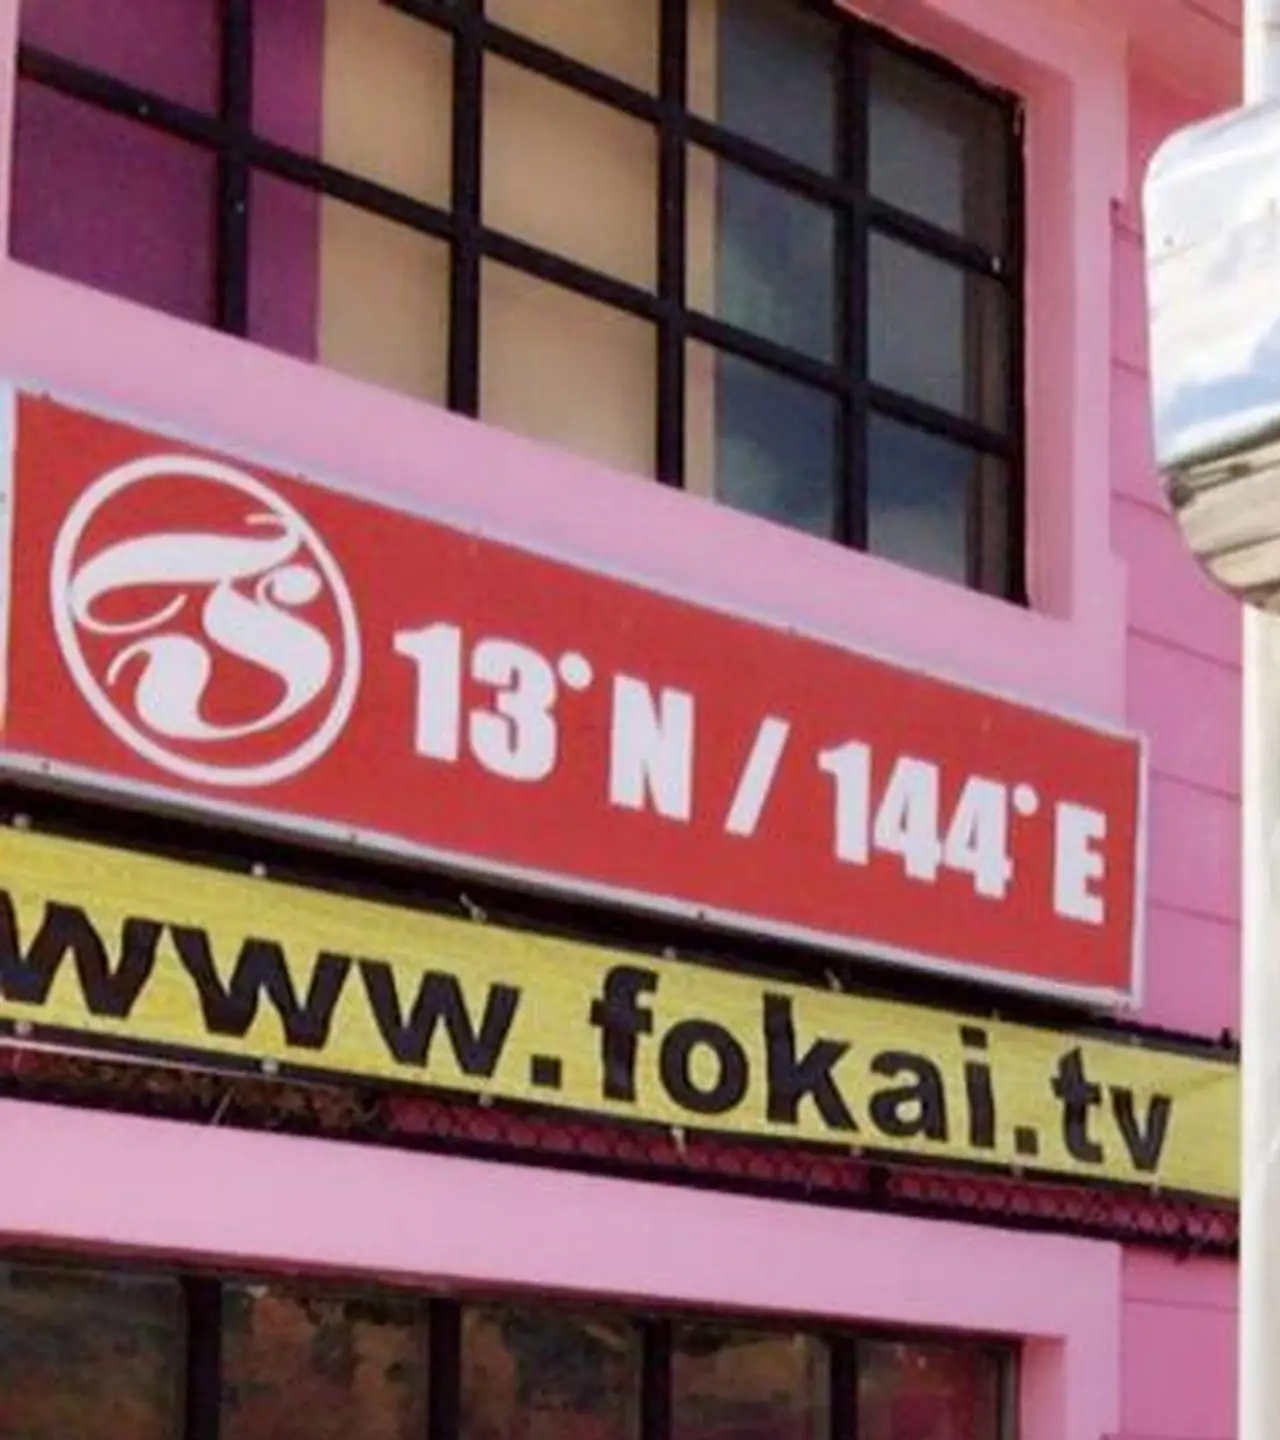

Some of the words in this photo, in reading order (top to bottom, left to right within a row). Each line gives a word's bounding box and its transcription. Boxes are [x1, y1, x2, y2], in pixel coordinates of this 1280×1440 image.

[608, 671, 696, 822] N
[1052, 801, 1108, 927] E
[0, 885, 1172, 1172] www.fokai.tv
